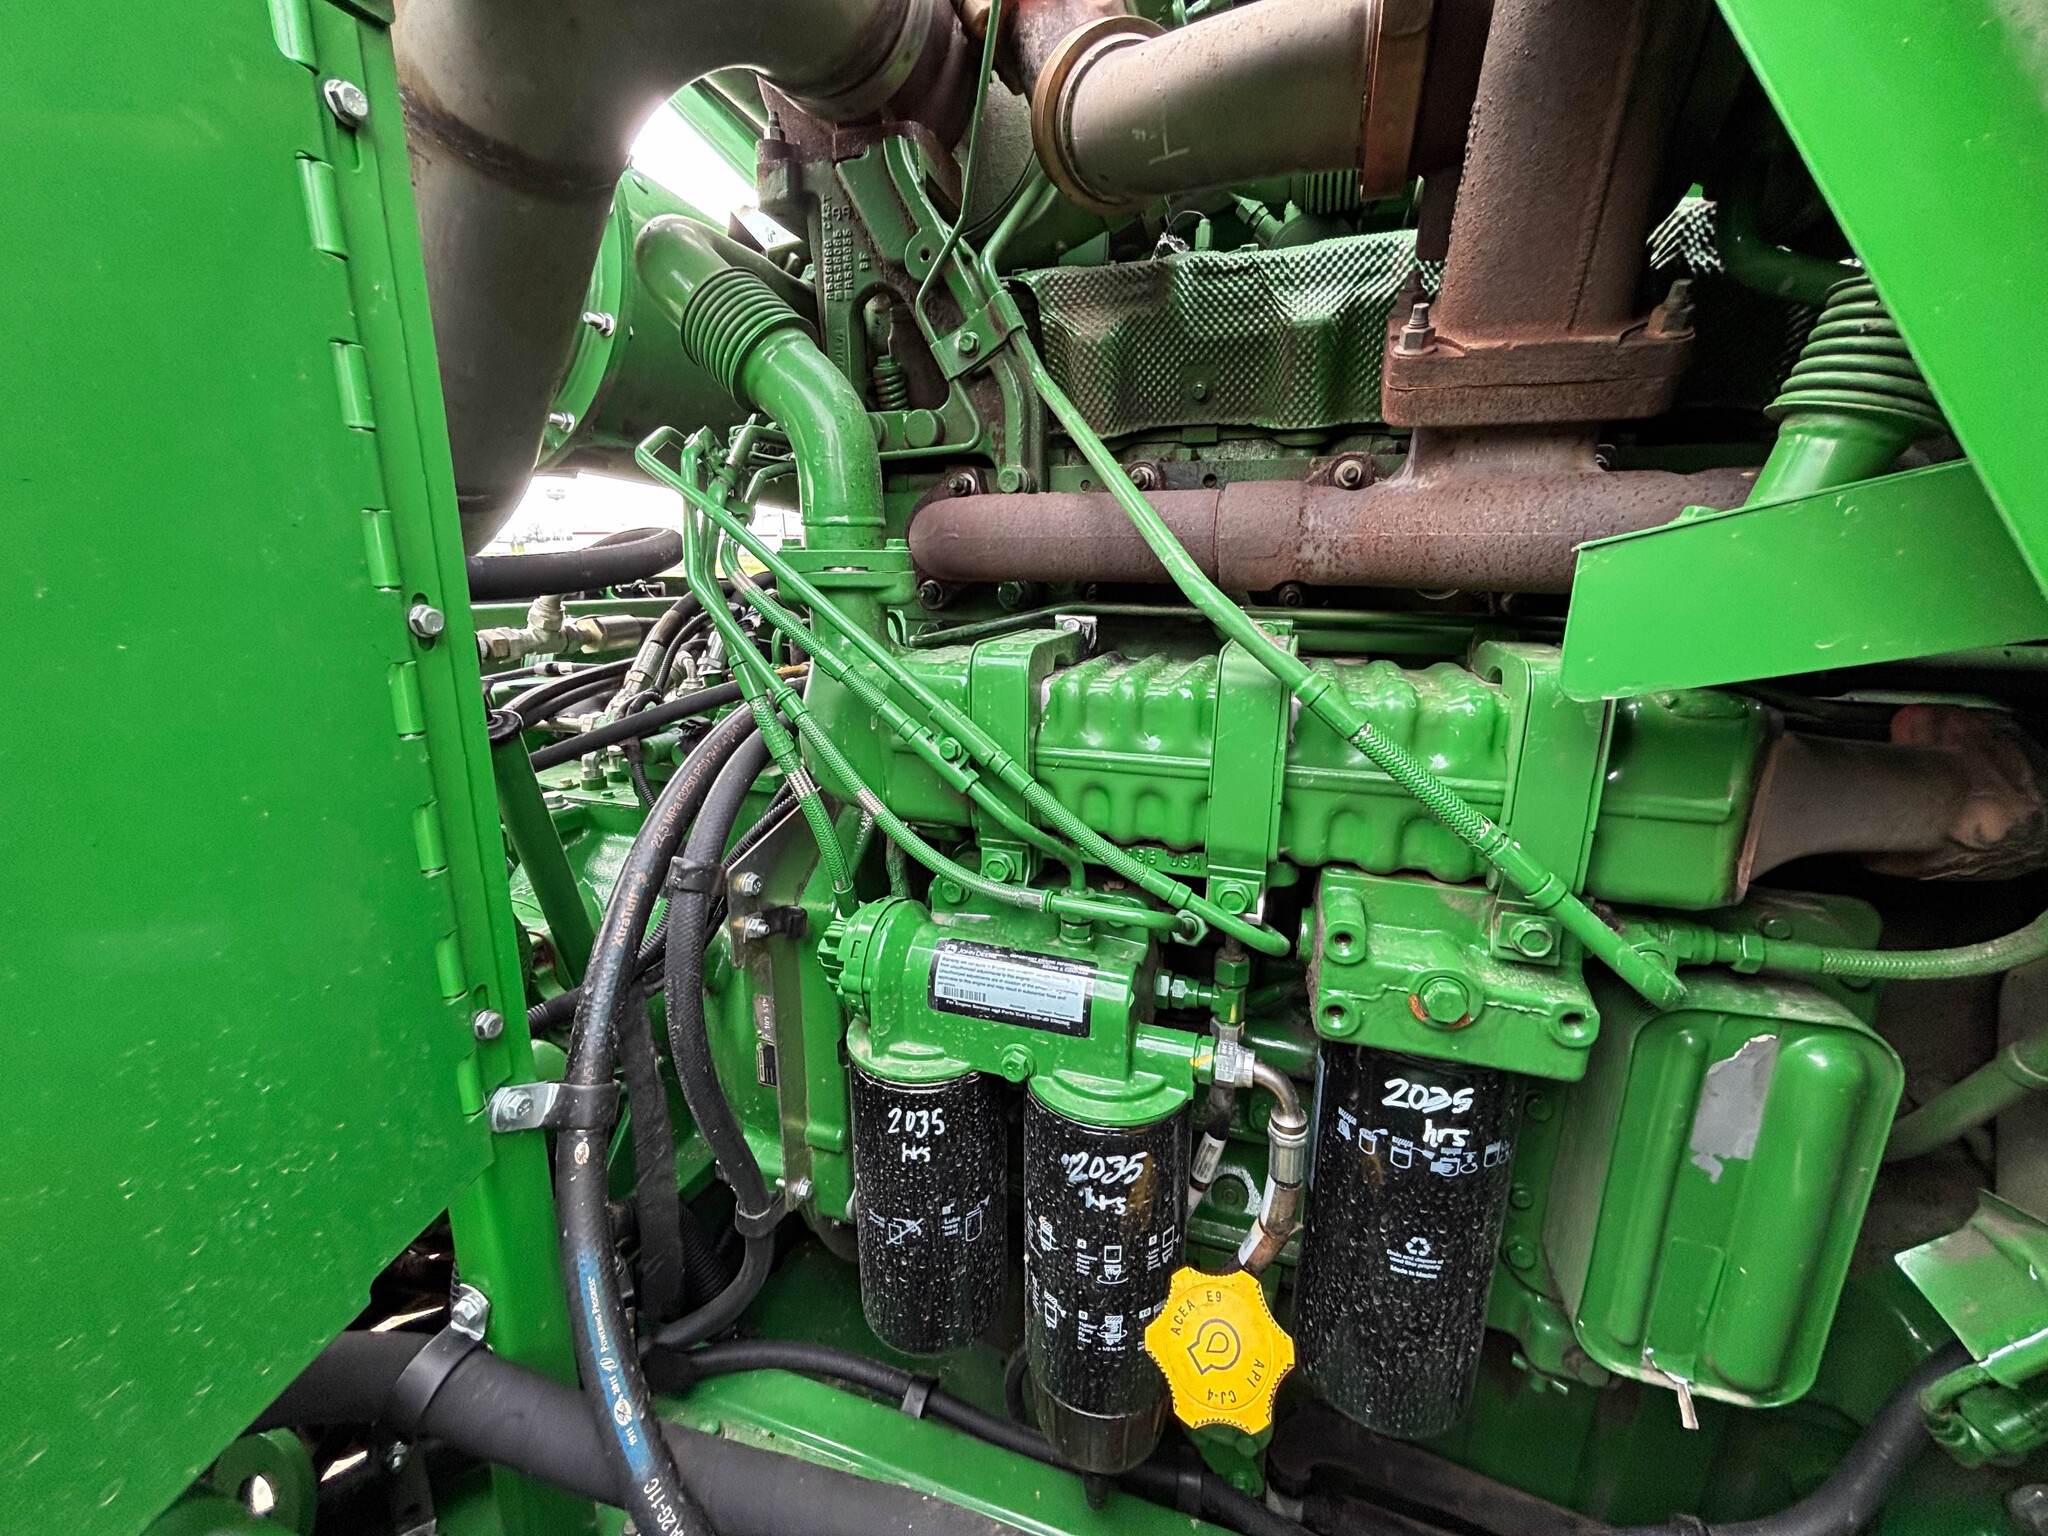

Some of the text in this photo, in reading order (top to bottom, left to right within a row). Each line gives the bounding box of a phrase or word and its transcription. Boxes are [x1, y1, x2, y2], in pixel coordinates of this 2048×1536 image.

[664, 801, 683, 825] MPa
[676, 775, 698, 805] (3250
[957, 947, 998, 959] JOHN DEERE
[887, 1108, 946, 1138] 2035
[1422, 1119, 1470, 1148] hrs
[1063, 1151, 1148, 1184] 2035
[1170, 1299, 1196, 1336] ACEA
[1206, 1290, 1222, 1303] E9
[594, 1314, 608, 1353] POWERING
[1207, 1358, 1265, 1405] API CJ-4
[644, 1478, 677, 1531] 2G-11C
